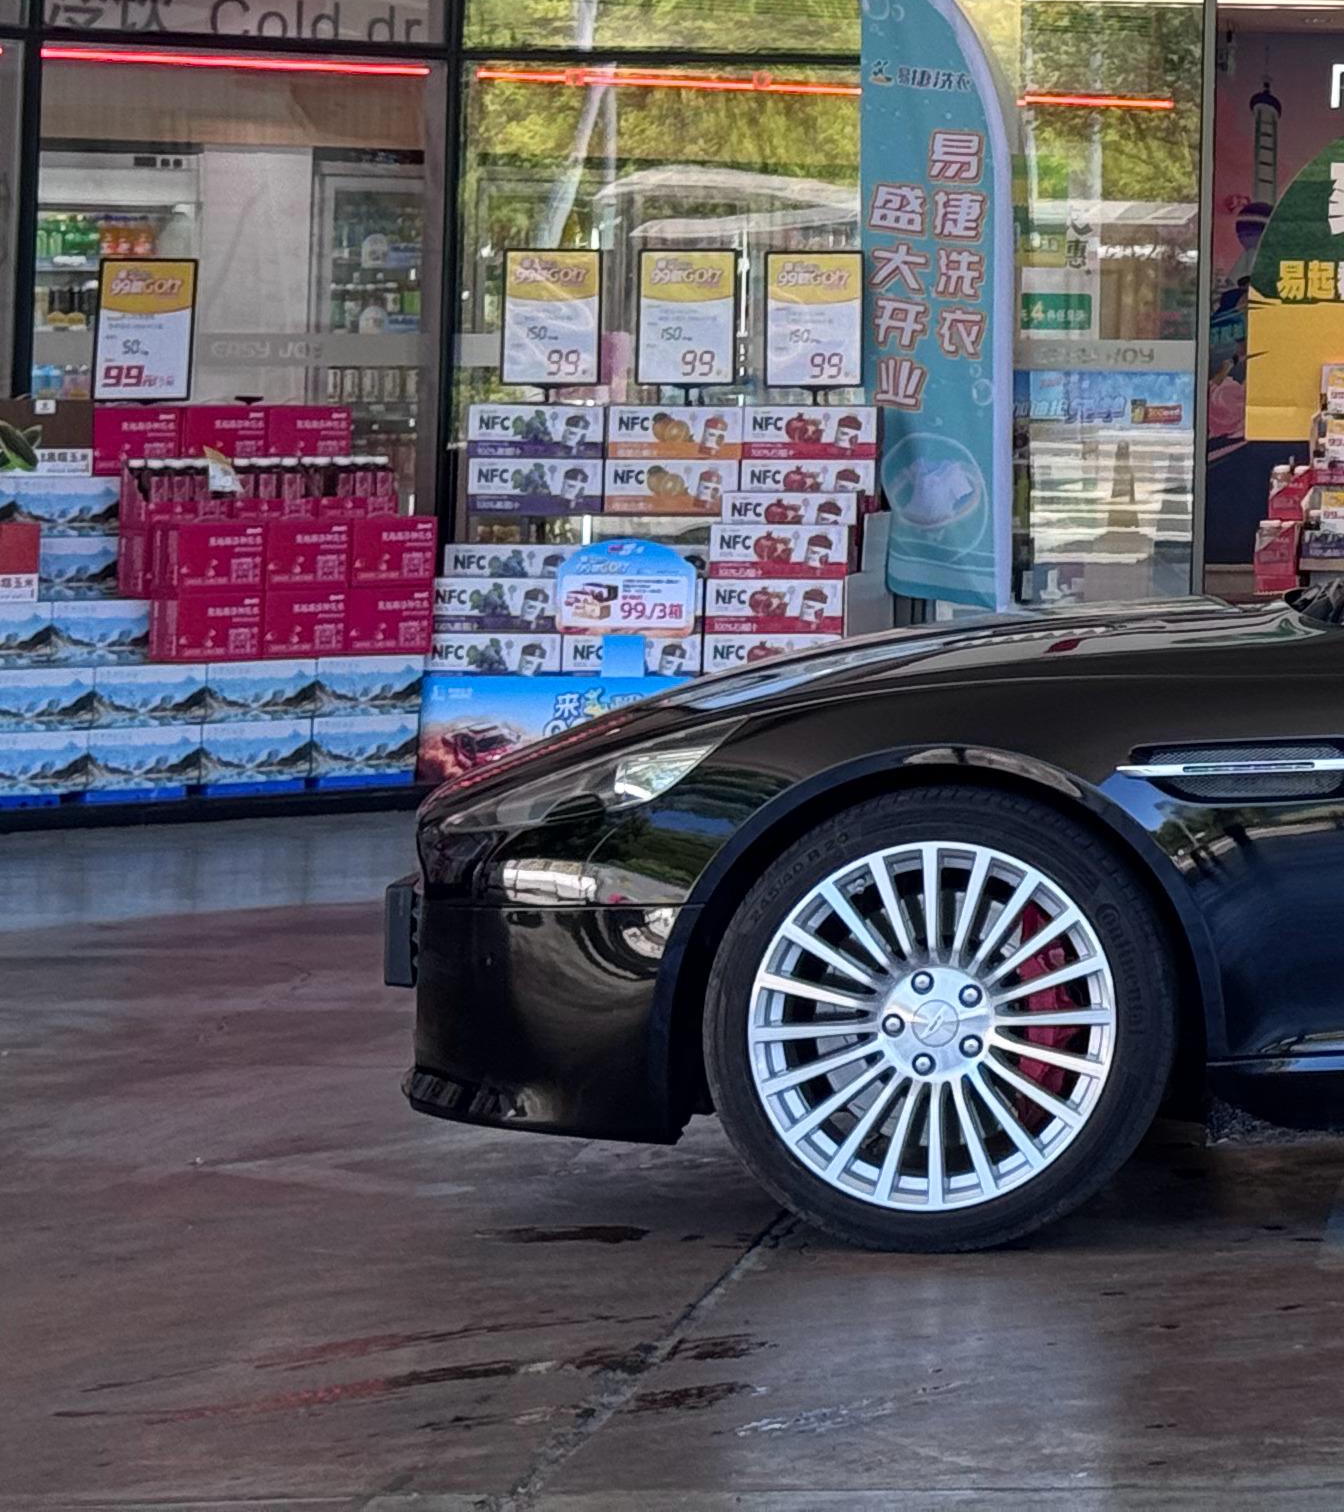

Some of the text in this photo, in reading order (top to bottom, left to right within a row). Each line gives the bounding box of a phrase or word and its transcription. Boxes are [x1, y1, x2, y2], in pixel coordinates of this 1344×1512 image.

[929, 130, 987, 358] 易捷洗衣
[868, 182, 929, 412] 盛大开业
[478, 415, 512, 432] NFC
[618, 415, 650, 432] NFC
[752, 416, 784, 432] NFC
[477, 468, 510, 484] NFC
[613, 469, 645, 485] NFC
[750, 469, 781, 485] NFC
[731, 502, 763, 518] NFC
[719, 534, 753, 551] NFC
[453, 554, 487, 571] NFC
[434, 589, 467, 606] NFC
[715, 589, 748, 605] NFC
[431, 644, 465, 662] NFC
[712, 645, 746, 661] NFC
